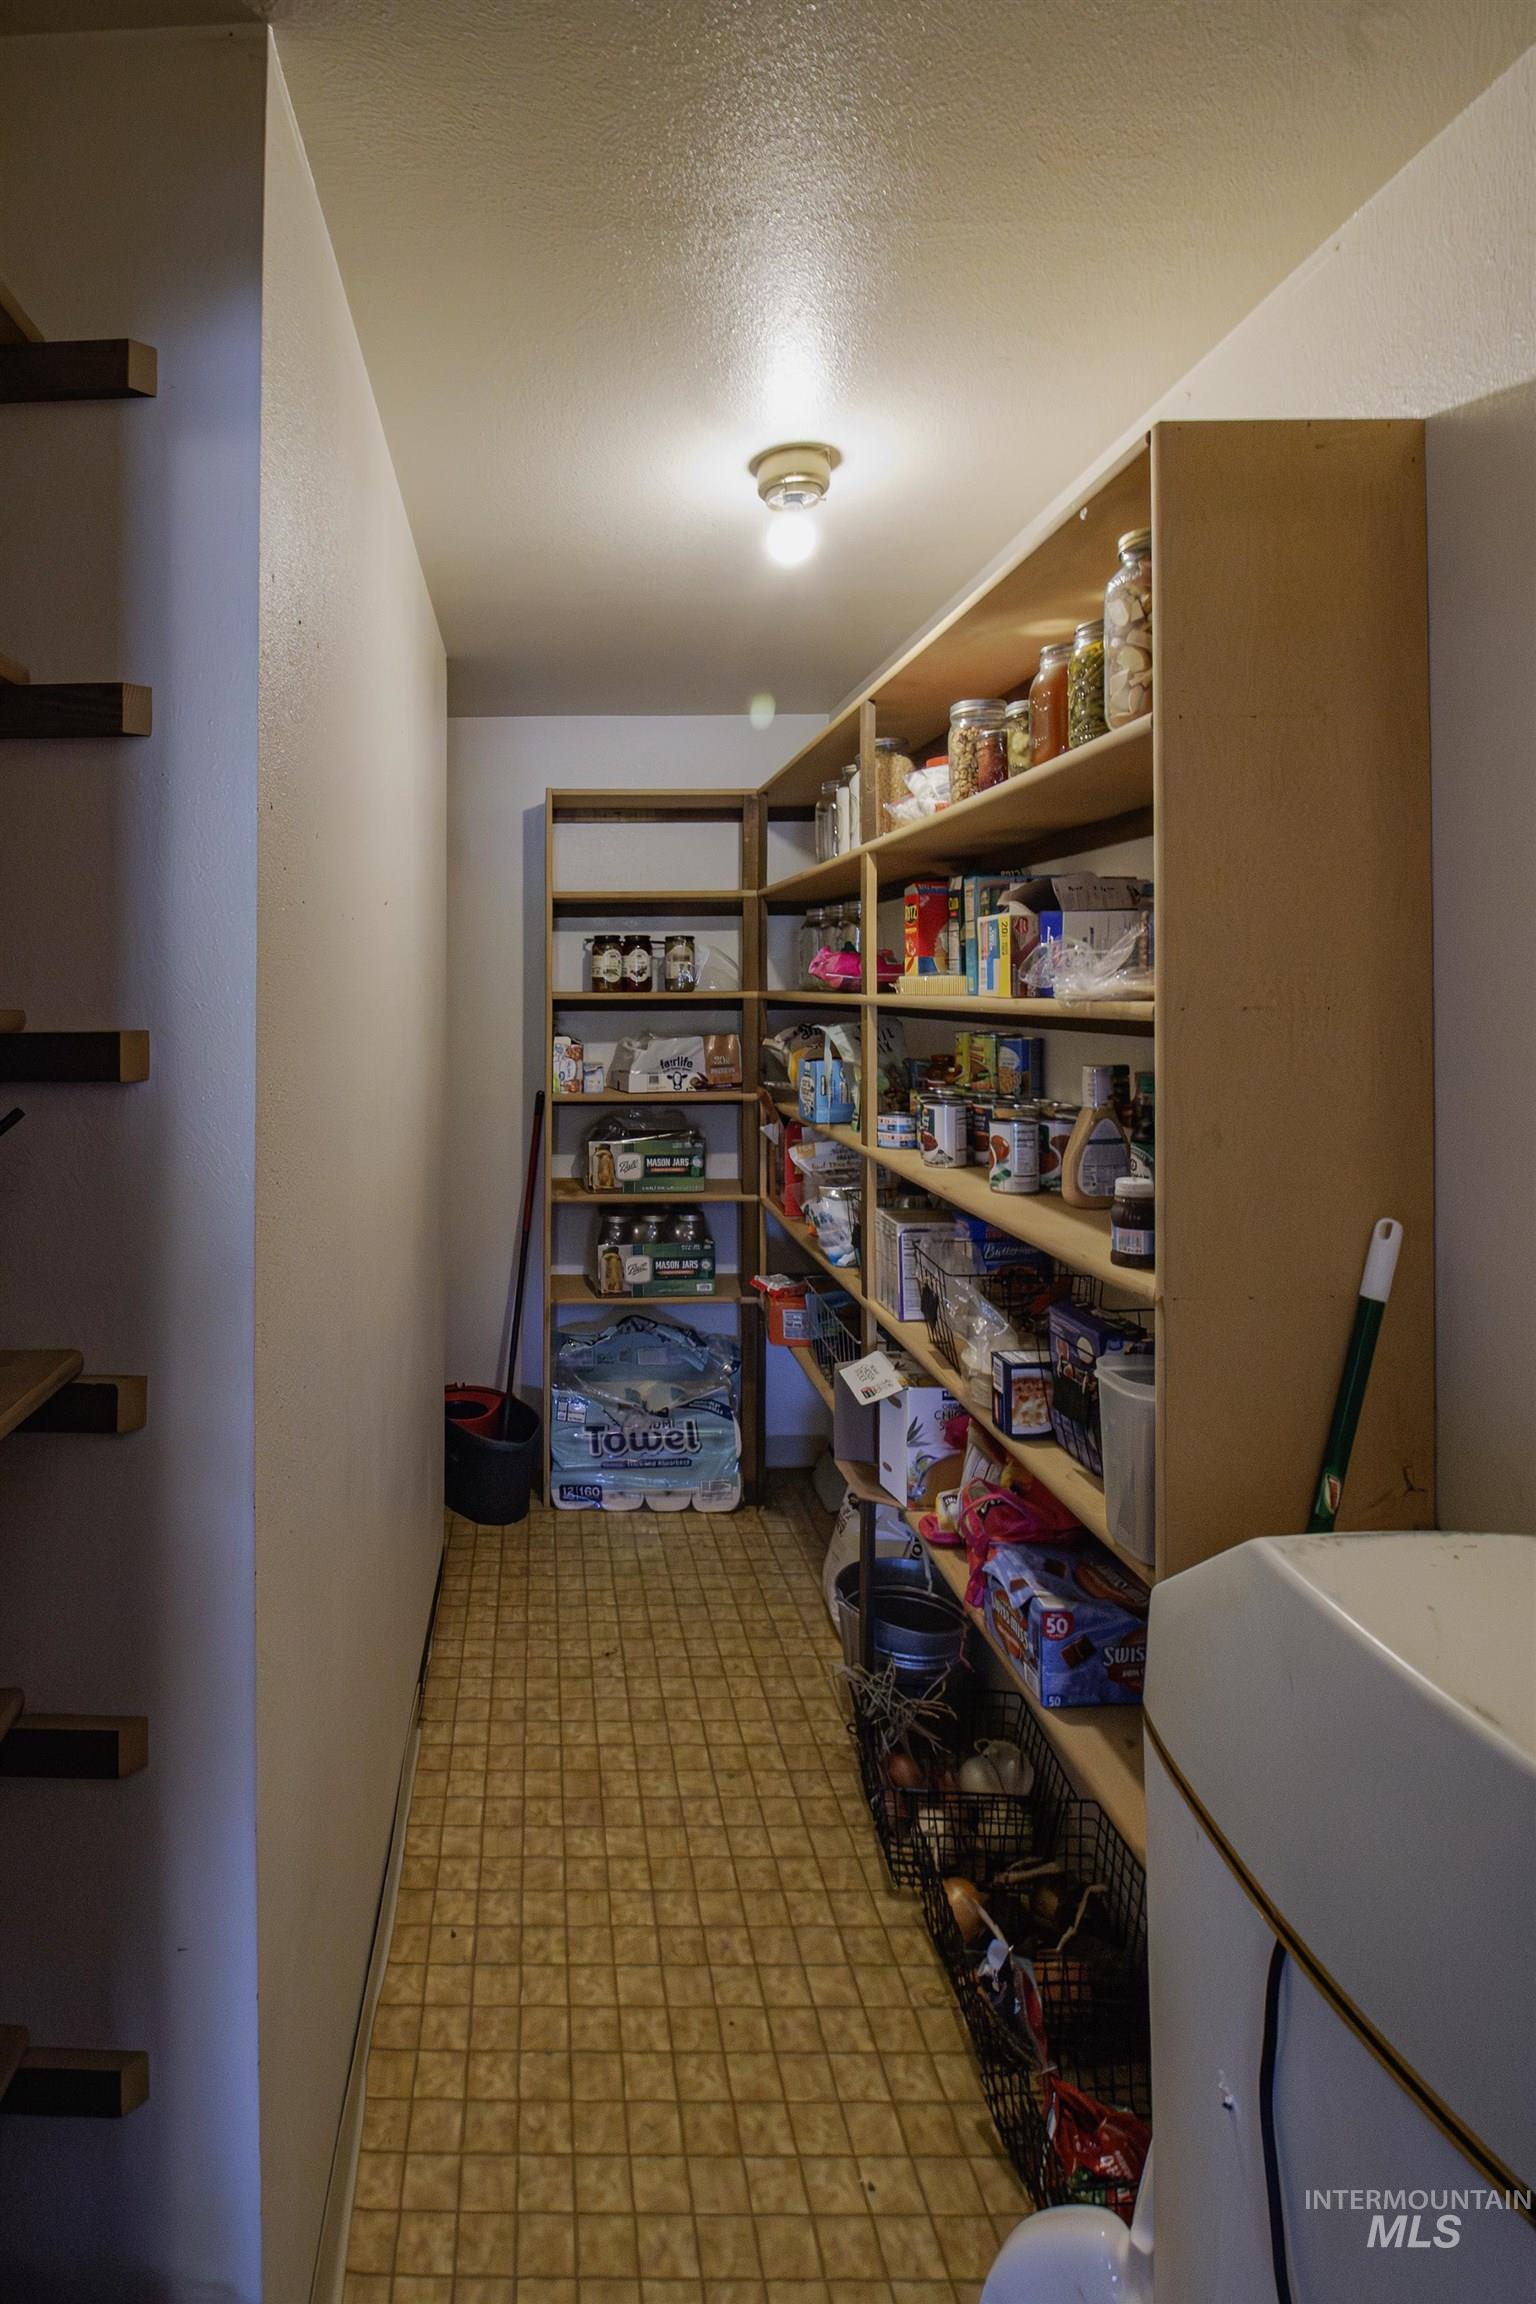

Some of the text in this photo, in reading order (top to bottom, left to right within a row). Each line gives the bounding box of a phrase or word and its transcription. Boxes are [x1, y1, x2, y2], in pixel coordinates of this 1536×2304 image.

[660, 1056, 694, 1070] fairlife
[646, 1157, 690, 1167] MASON JARS
[656, 1260, 699, 1270] MASON JARS
[585, 1419, 700, 1455] Towel
[580, 1486, 600, 1498] 160
[1046, 1617, 1069, 1635] 50
[1049, 1697, 1061, 1707] 50
